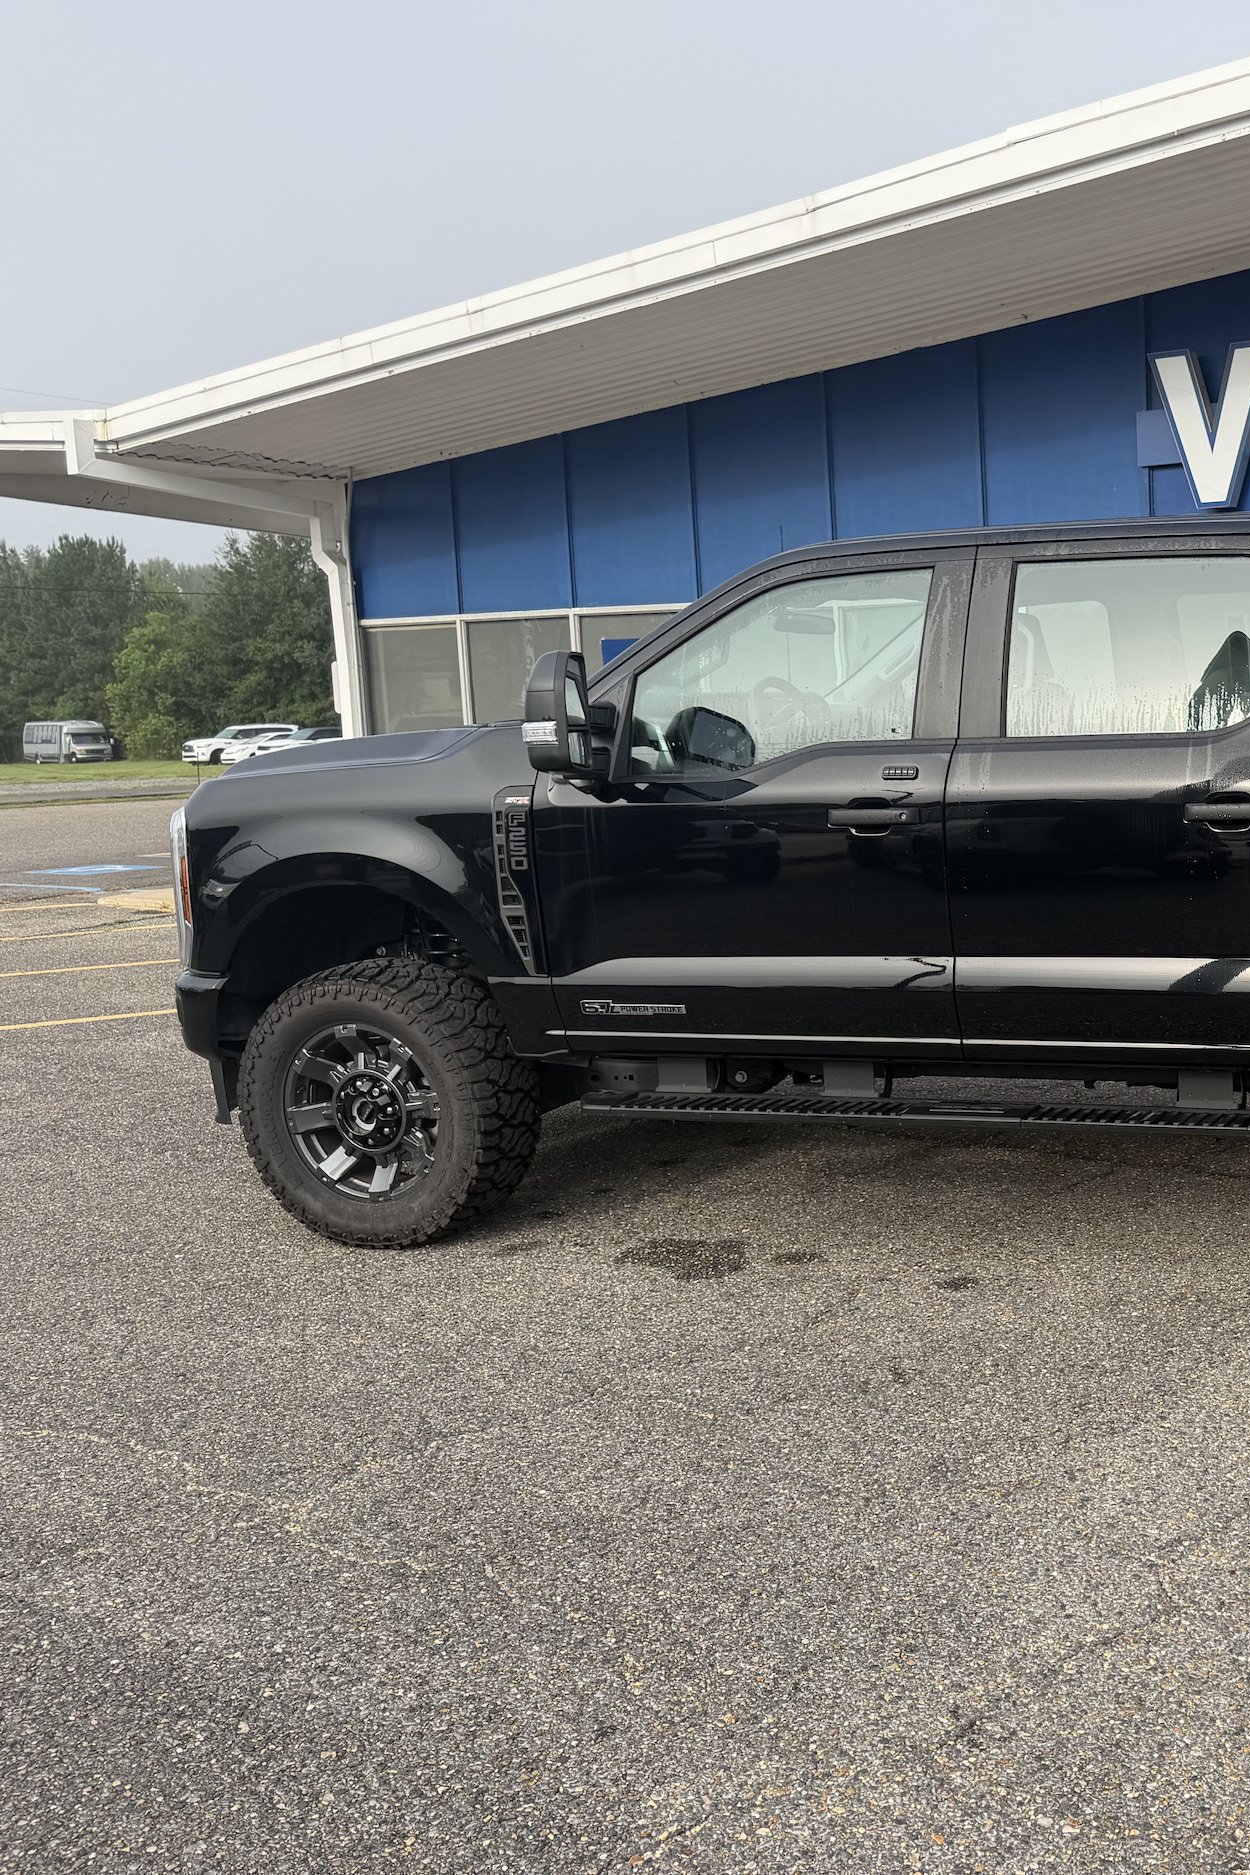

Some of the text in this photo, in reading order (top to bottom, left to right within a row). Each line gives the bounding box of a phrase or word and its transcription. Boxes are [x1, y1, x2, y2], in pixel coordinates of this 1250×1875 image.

[508, 812, 528, 870] F250
[620, 1005, 649, 1014] POWER
[651, 1005, 683, 1014] STROKE
